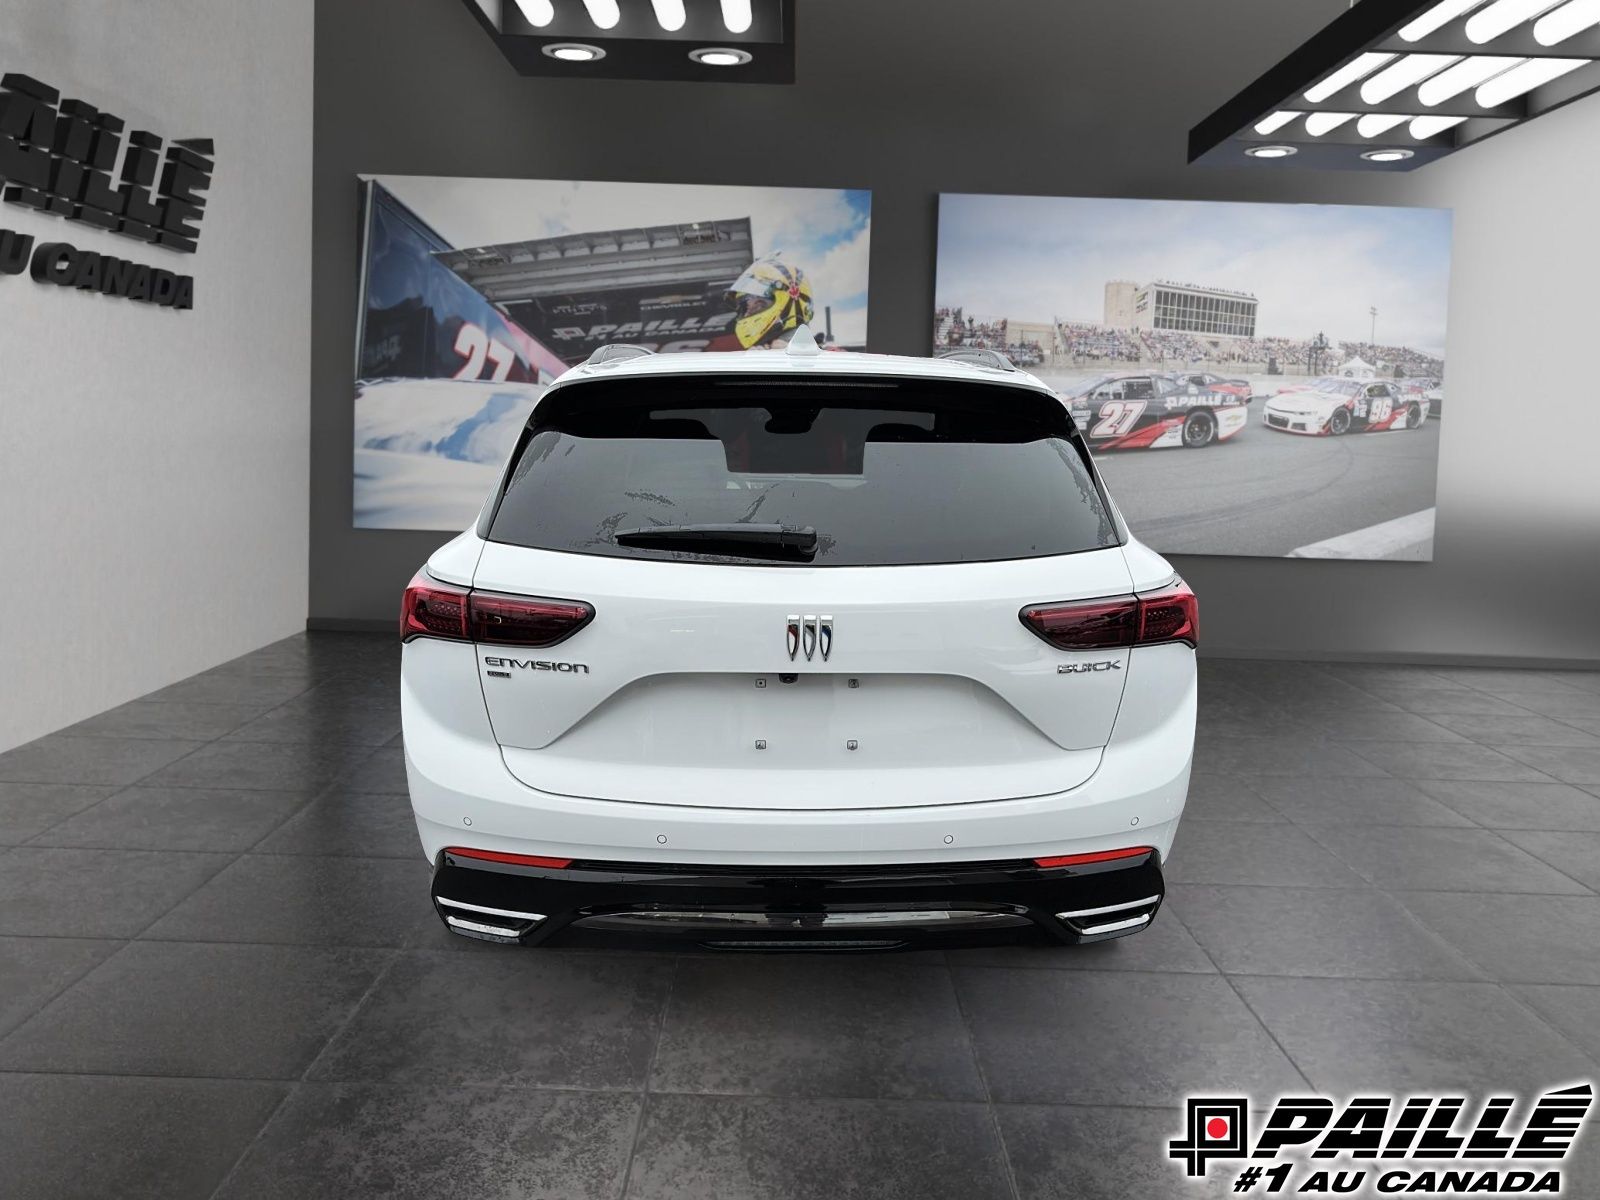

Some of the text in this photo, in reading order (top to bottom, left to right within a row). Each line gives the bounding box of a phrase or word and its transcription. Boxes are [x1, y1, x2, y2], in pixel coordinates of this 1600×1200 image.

[0, 73, 214, 253] AILLÉ
[30, 242, 193, 309] CANADA
[453, 321, 515, 383] 27
[1090, 400, 1148, 438] 27
[484, 656, 590, 674] ENVISION
[1057, 660, 1121, 674] BUICK
